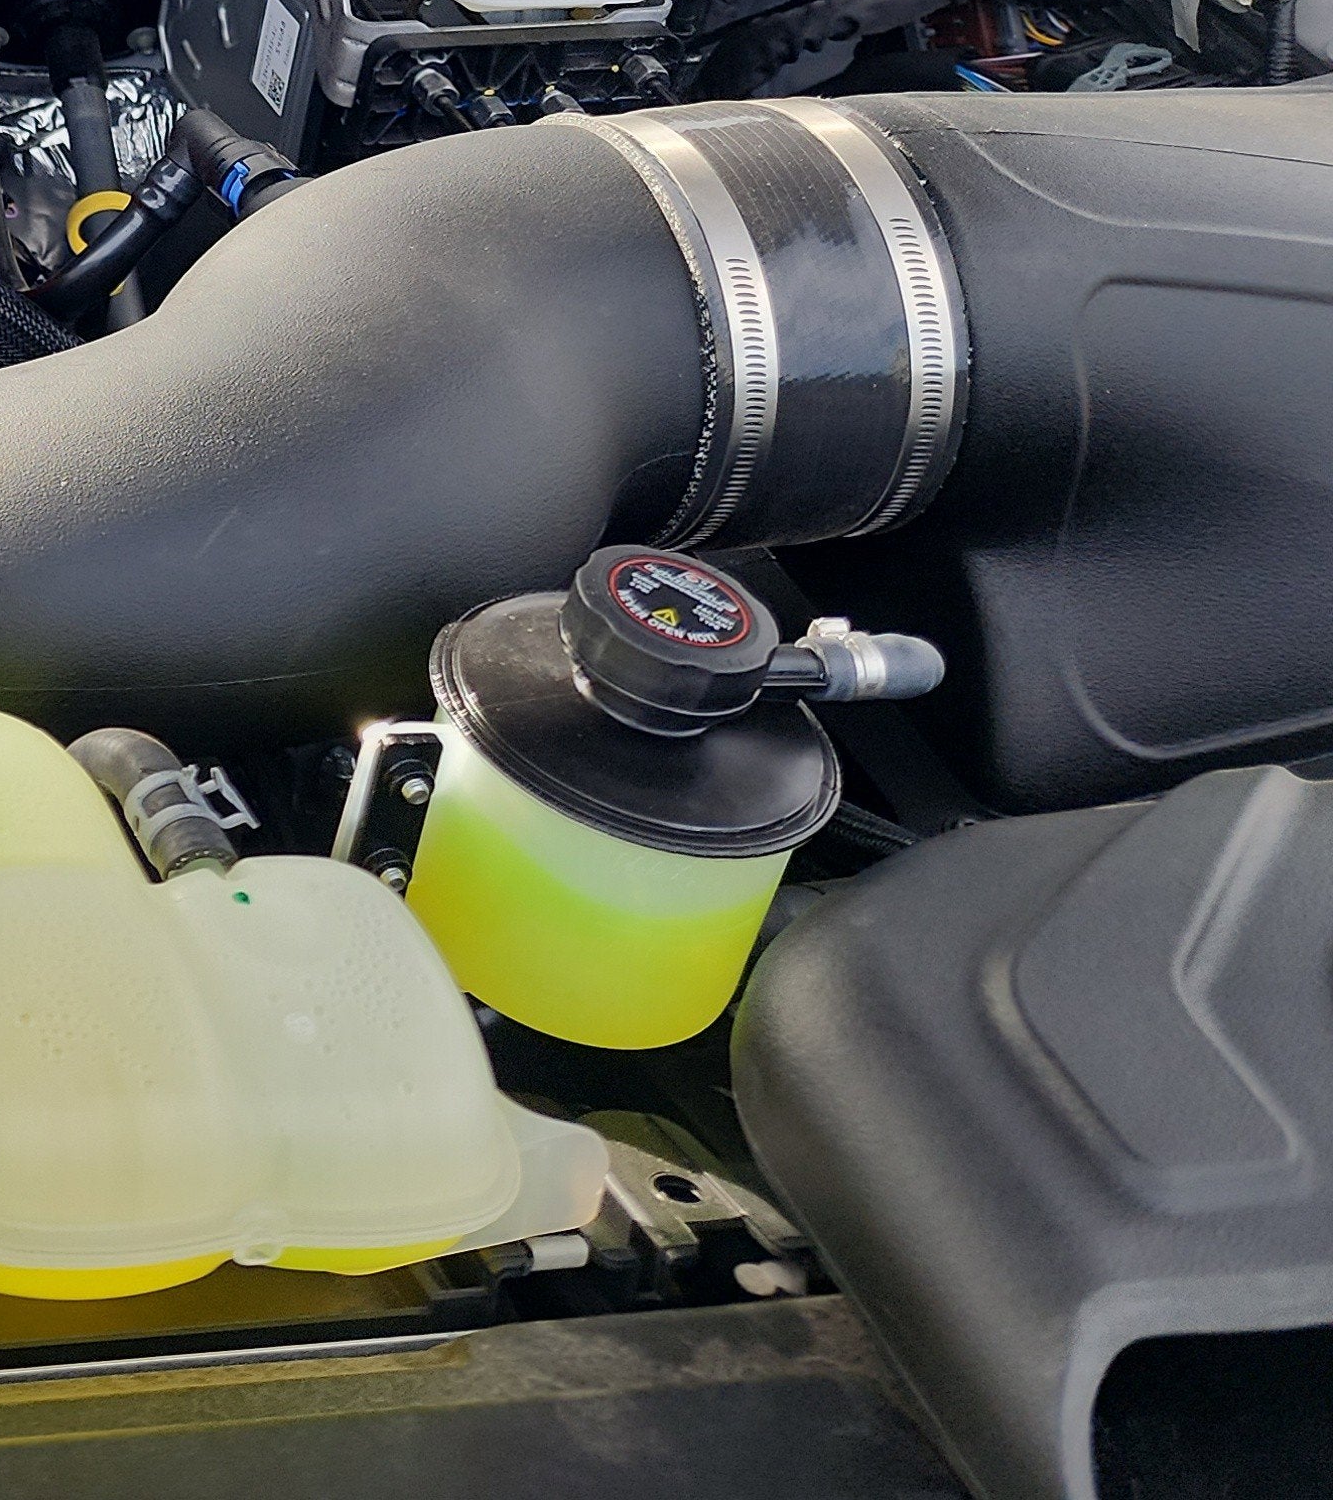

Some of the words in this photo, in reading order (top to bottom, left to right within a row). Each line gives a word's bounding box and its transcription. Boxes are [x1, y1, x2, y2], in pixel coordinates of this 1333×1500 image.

[617, 589, 651, 620] NEVER
[647, 618, 687, 639] OPEN
[686, 630, 720, 644] HOT!
